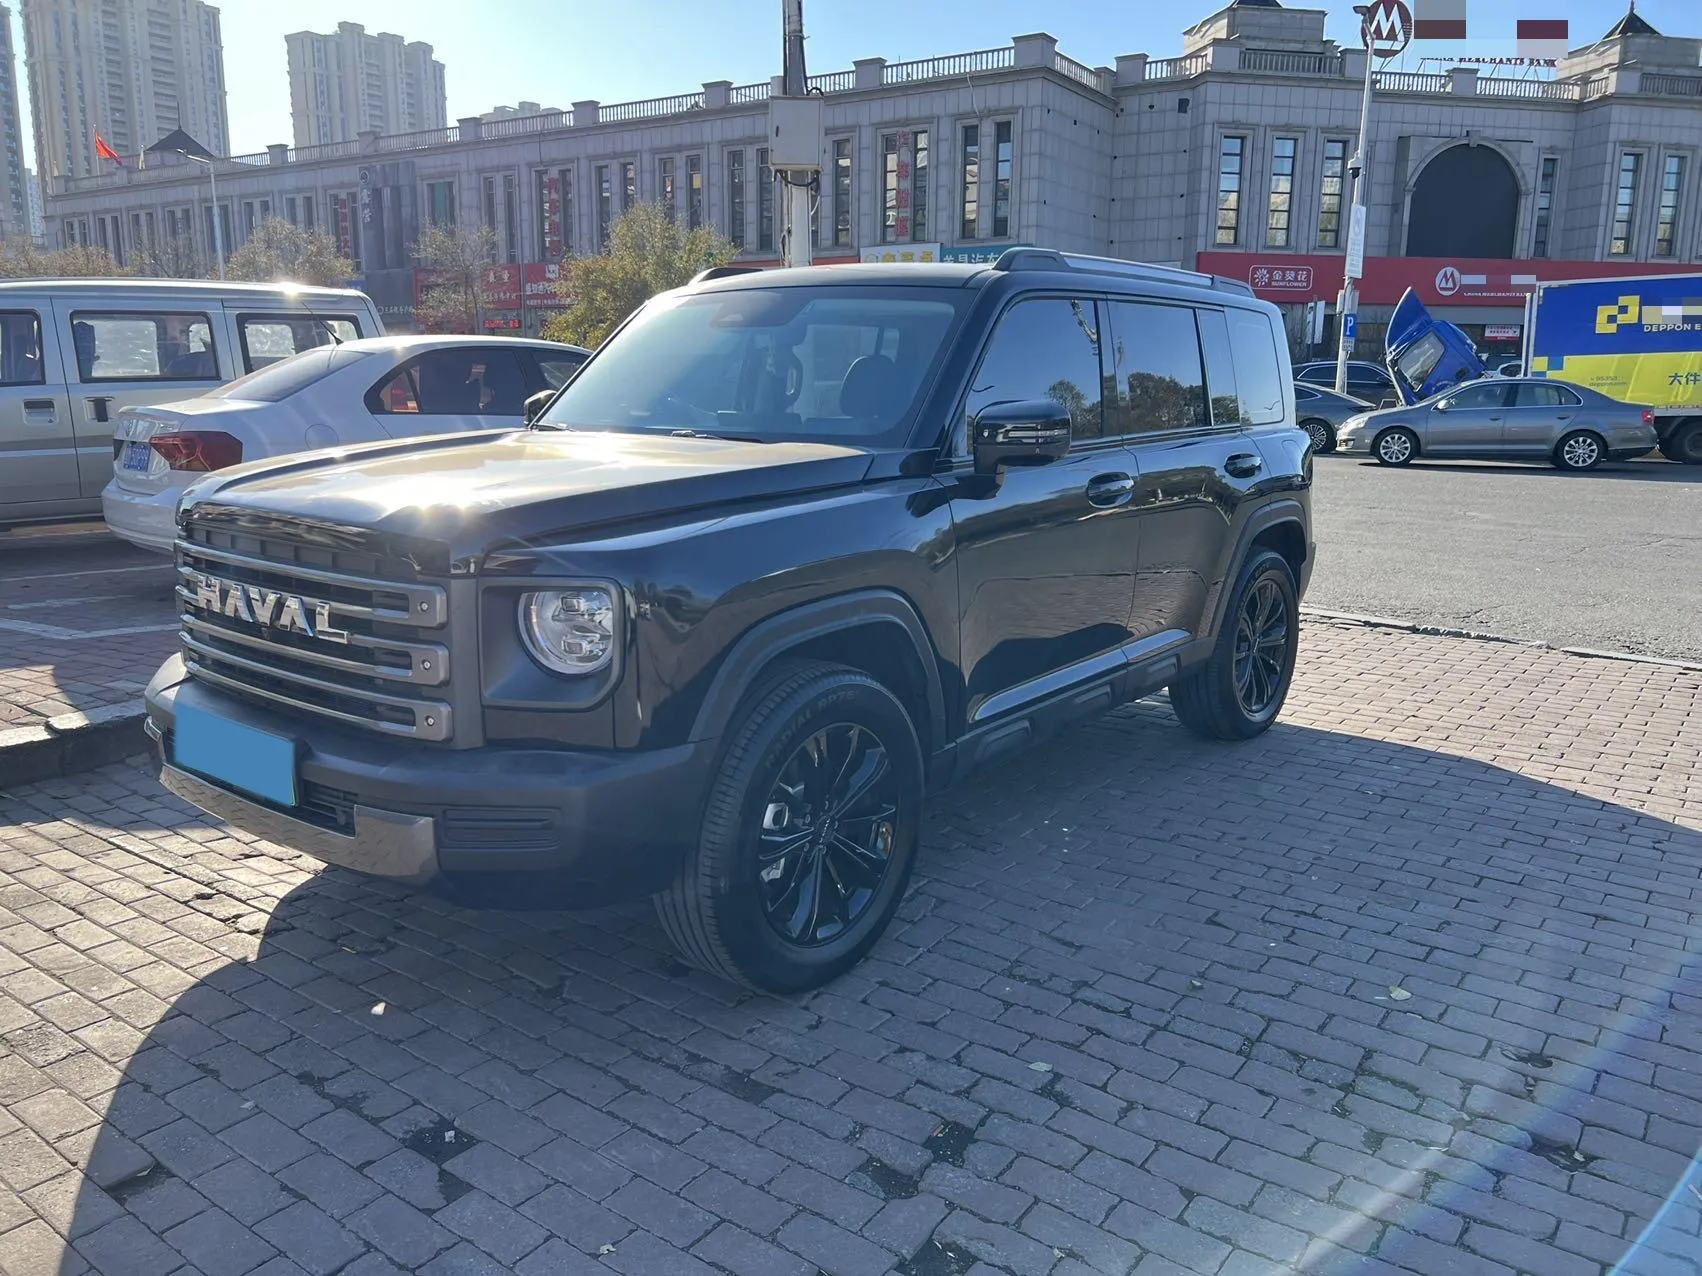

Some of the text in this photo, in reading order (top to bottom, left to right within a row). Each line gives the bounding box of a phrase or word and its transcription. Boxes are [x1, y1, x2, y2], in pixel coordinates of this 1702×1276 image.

[1271, 270, 1308, 282] 金葵花
[1345, 316, 1354, 336] P
[1643, 323, 1691, 332] DEPPON
[1668, 371, 1701, 386] 大件
[196, 574, 349, 645] HAVAL
